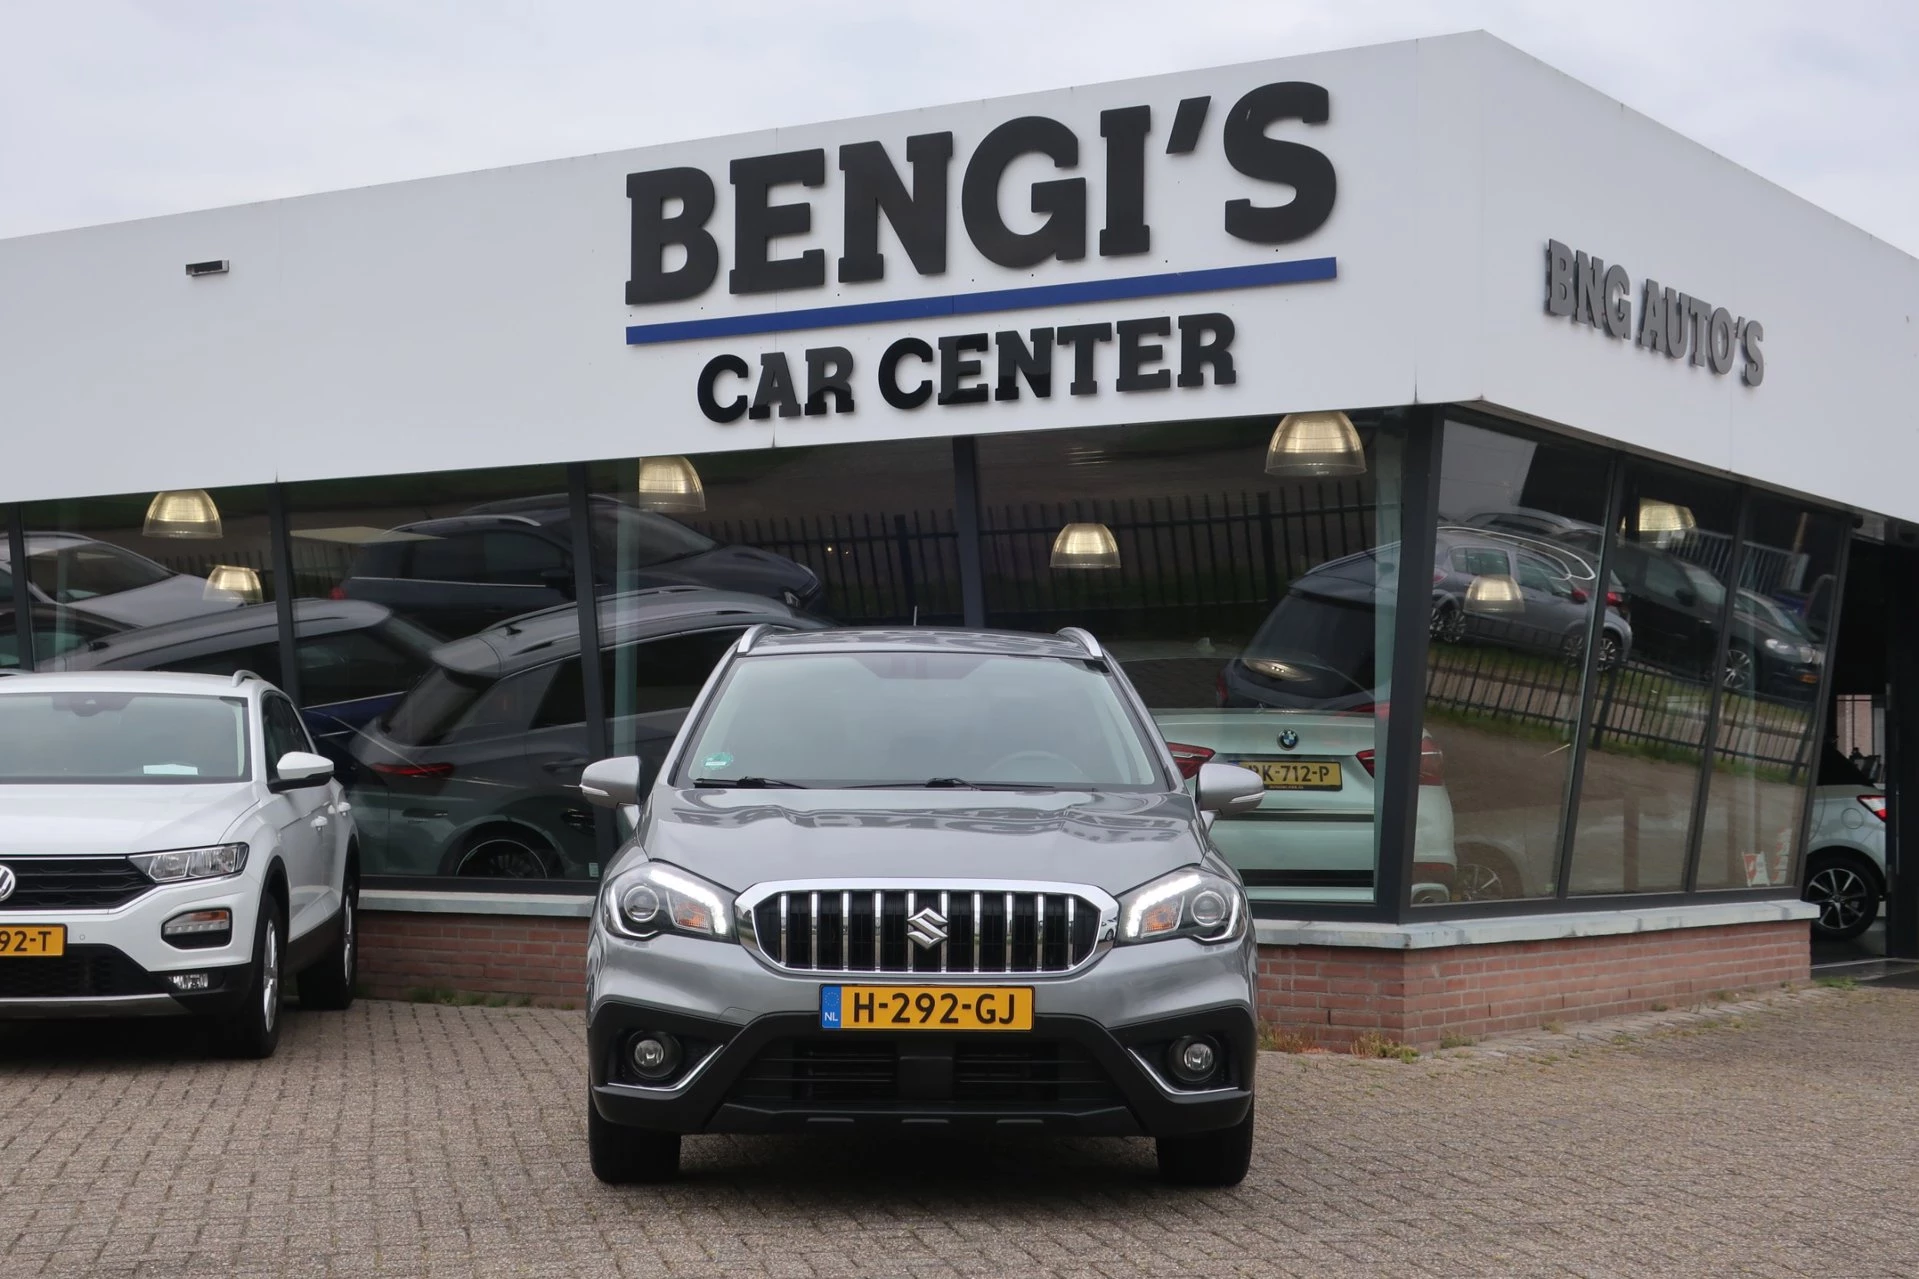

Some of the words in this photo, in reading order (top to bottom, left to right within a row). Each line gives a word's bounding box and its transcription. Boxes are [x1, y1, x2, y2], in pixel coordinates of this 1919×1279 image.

[625, 81, 1338, 305] BENGI'S
[697, 345, 855, 424] CAR
[878, 312, 1237, 410] CENTER
[1547, 238, 1631, 340] BNG
[1640, 278, 1764, 387] AUTO'S
[824, 1012, 838, 1022] NL
[853, 992, 1015, 1024] H-292-GJ
